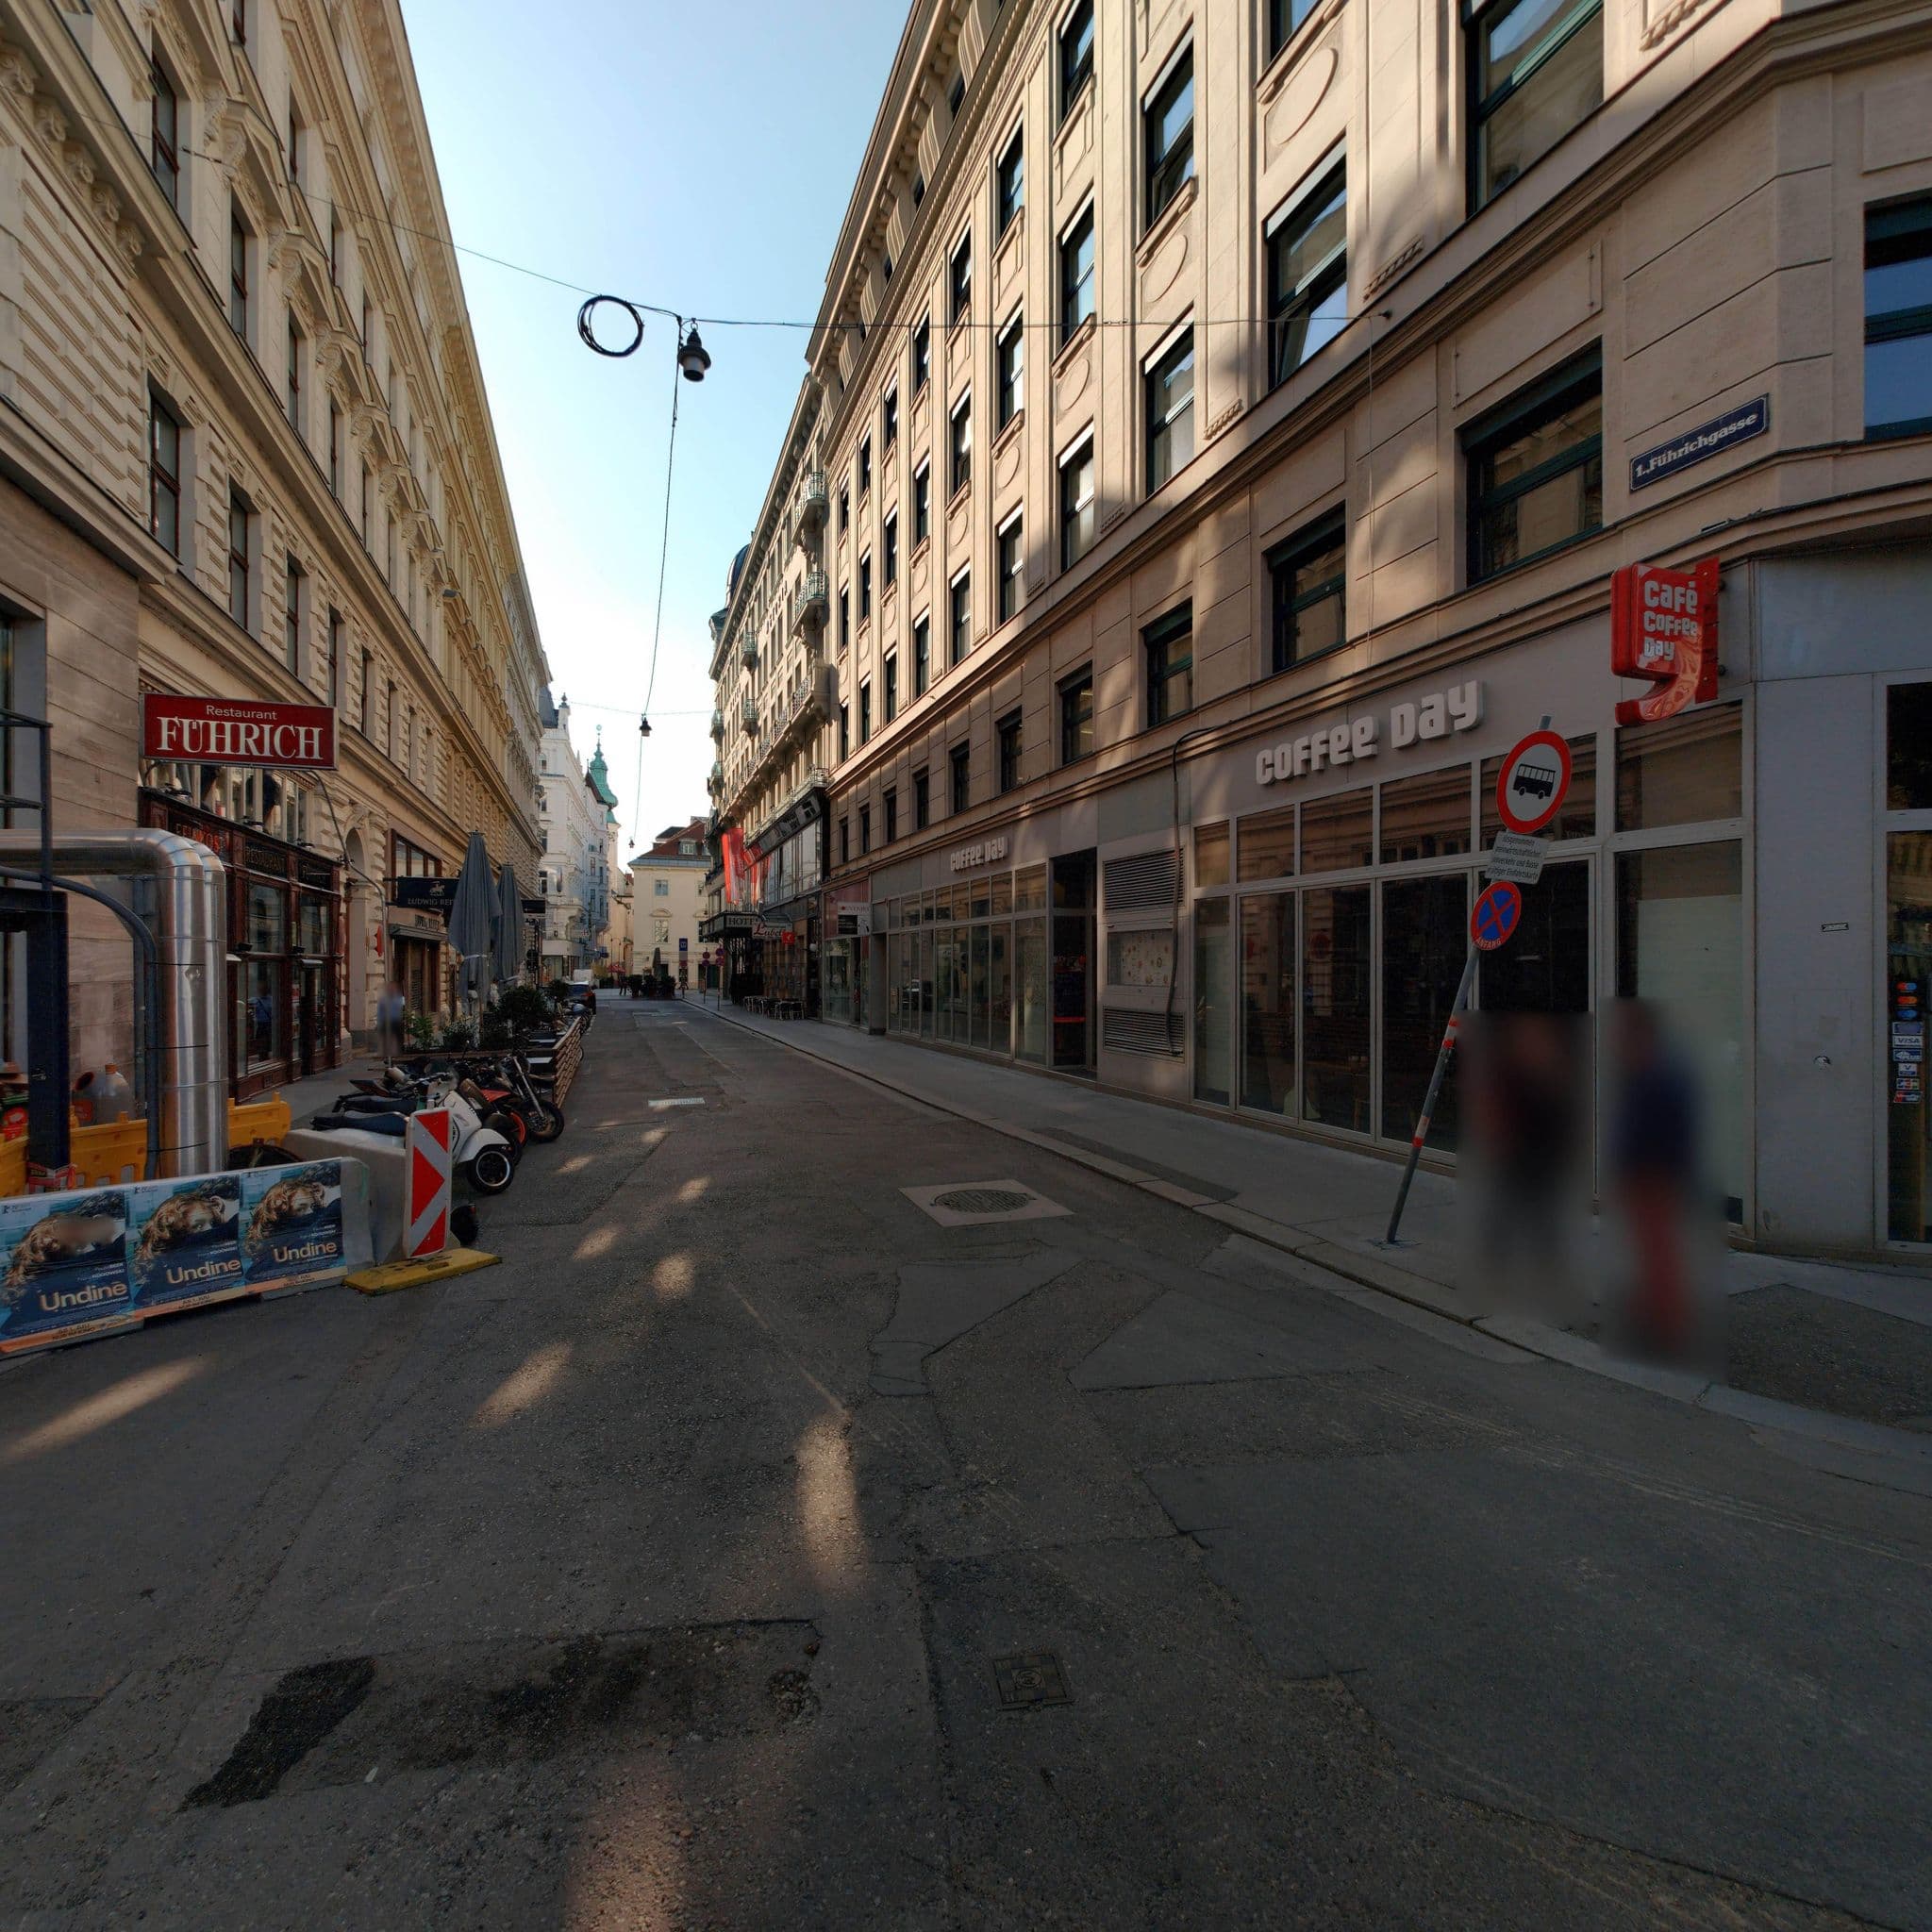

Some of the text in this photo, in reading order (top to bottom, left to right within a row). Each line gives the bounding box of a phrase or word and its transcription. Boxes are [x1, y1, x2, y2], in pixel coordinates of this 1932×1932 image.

[1650, 413, 1758, 470] Führichgasse
[1643, 580, 1698, 615] Café
[1643, 637, 1675, 661] Day
[206, 705, 277, 721] Restaurant
[1390, 680, 1483, 749] Day
[157, 716, 324, 760] FÜHRICH
[274, 1241, 337, 1262] Undine
[166, 1258, 242, 1285] Undine
[40, 1281, 127, 1312] Undine
